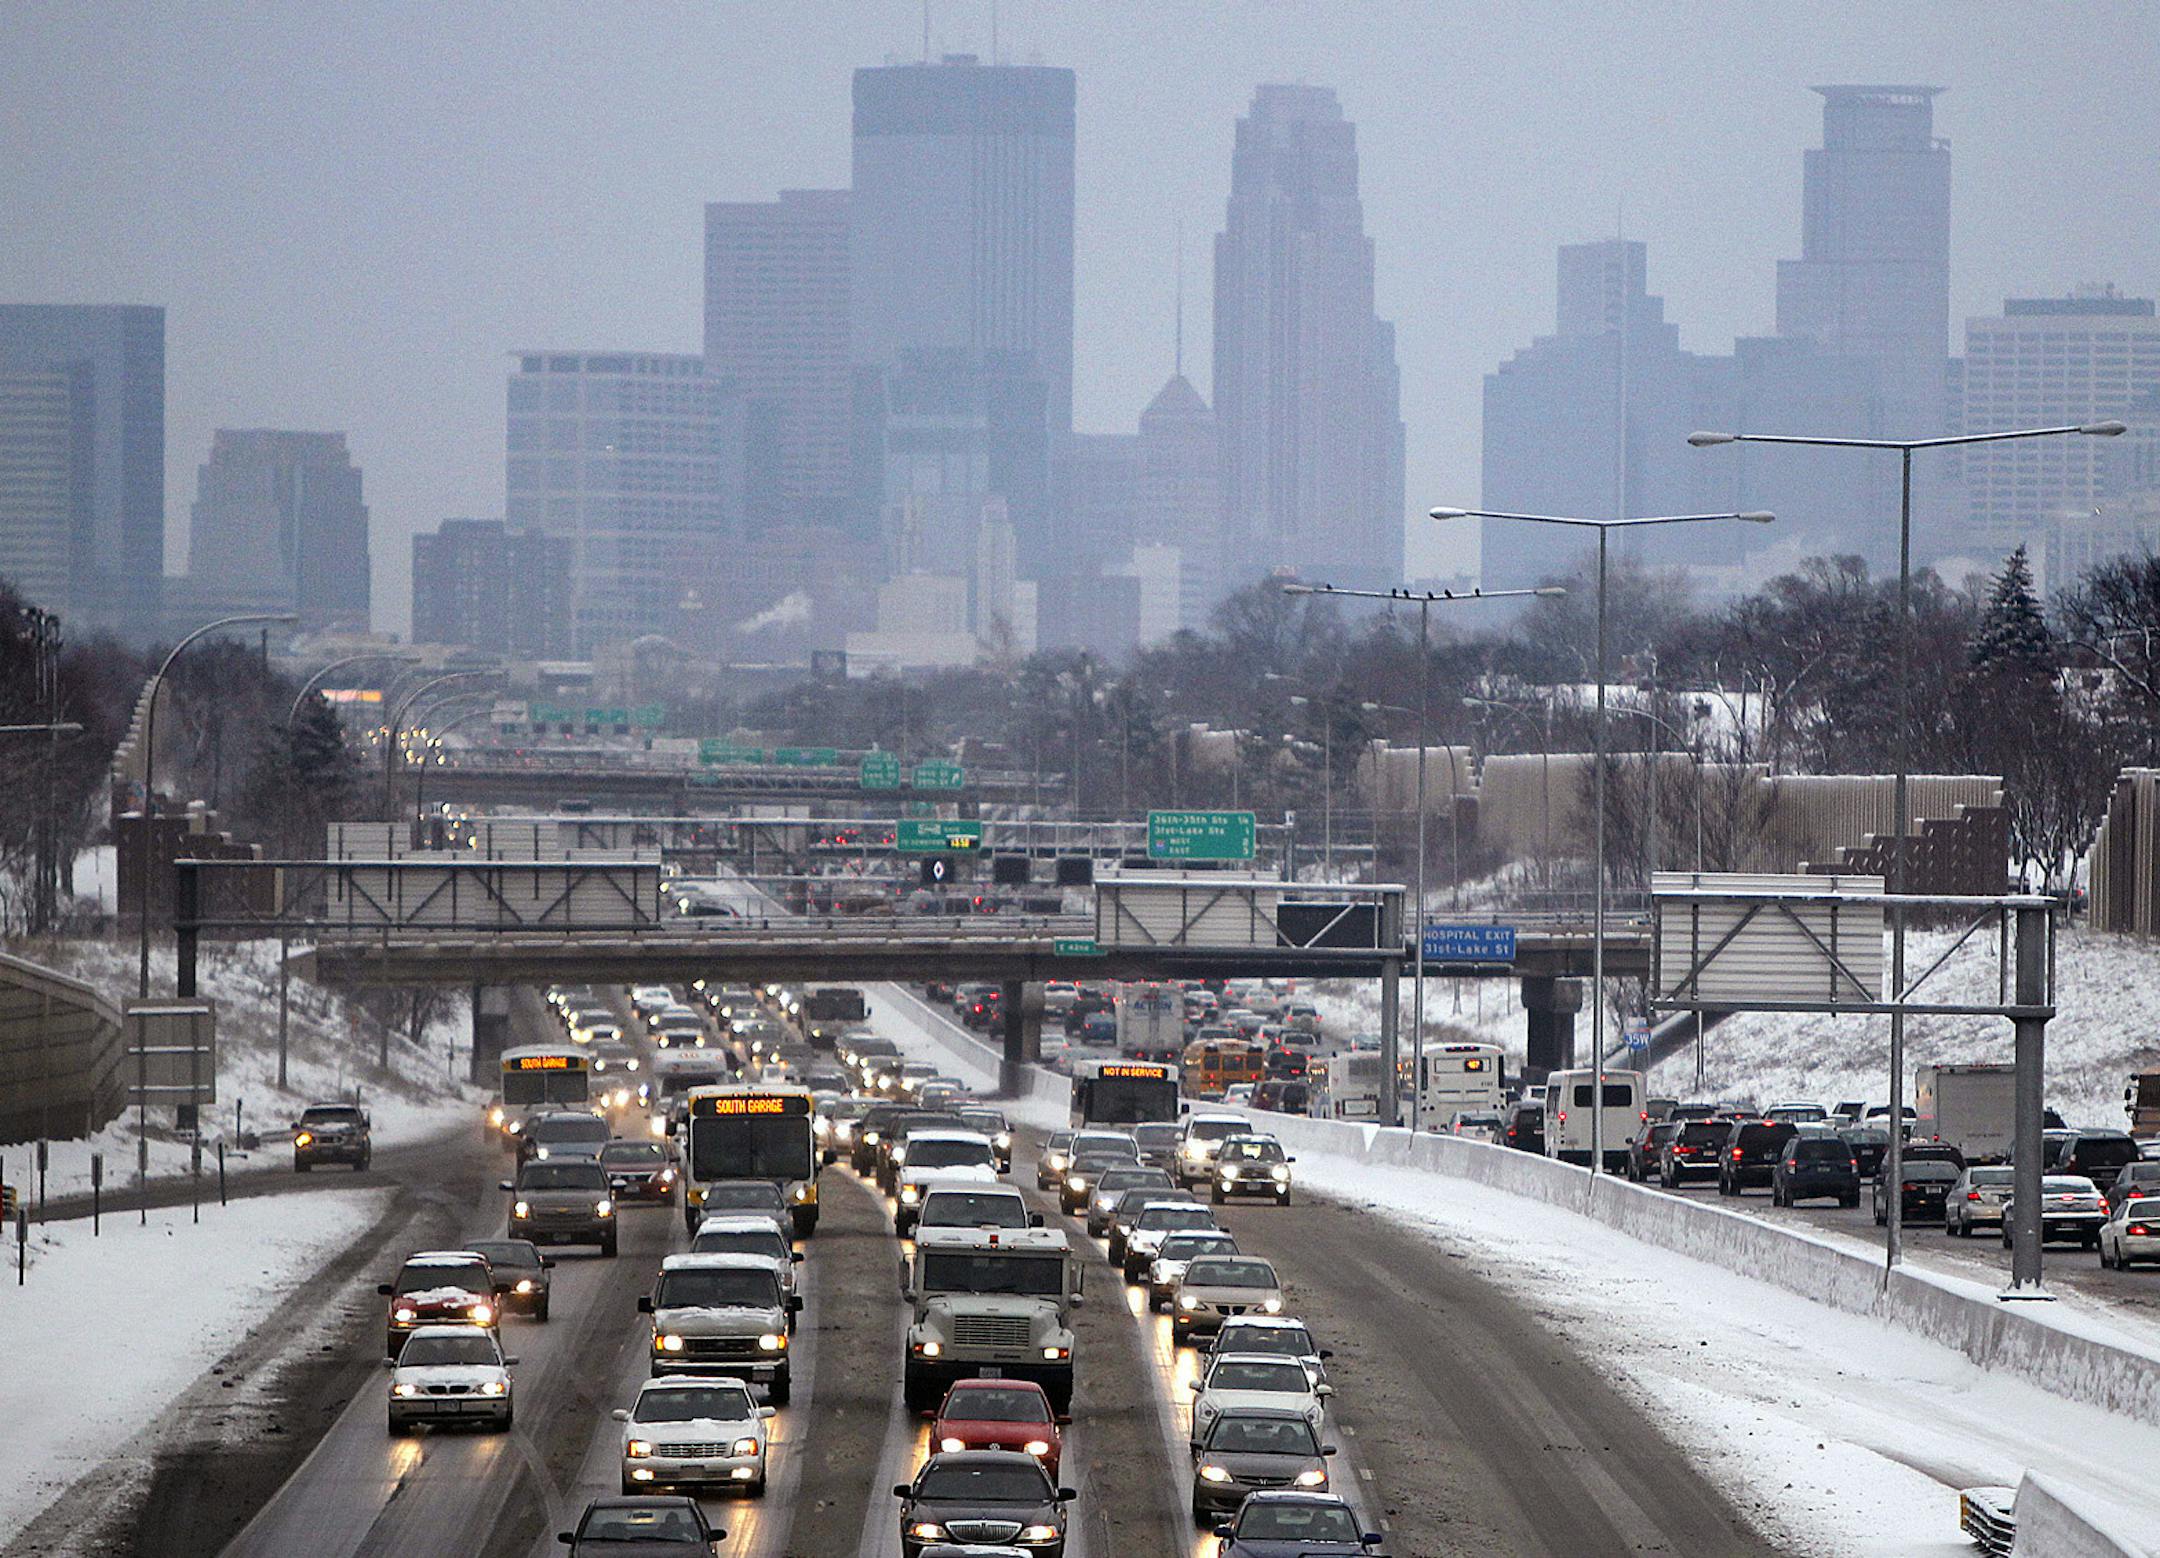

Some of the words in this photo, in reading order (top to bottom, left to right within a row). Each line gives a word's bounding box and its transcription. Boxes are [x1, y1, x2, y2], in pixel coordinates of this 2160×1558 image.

[1485, 930, 1511, 940] EXIT
[1424, 943, 1489, 954] 31st-Lake
[1495, 943, 1509, 954] St
[1625, 1032, 1650, 1045] 35W
[1103, 1066, 1120, 1077] NOT
[1121, 1067, 1130, 1077] IN
[1130, 1067, 1164, 1078] SERVICE
[716, 1099, 747, 1114] SOUTH
[747, 1098, 784, 1113] GARAGE
